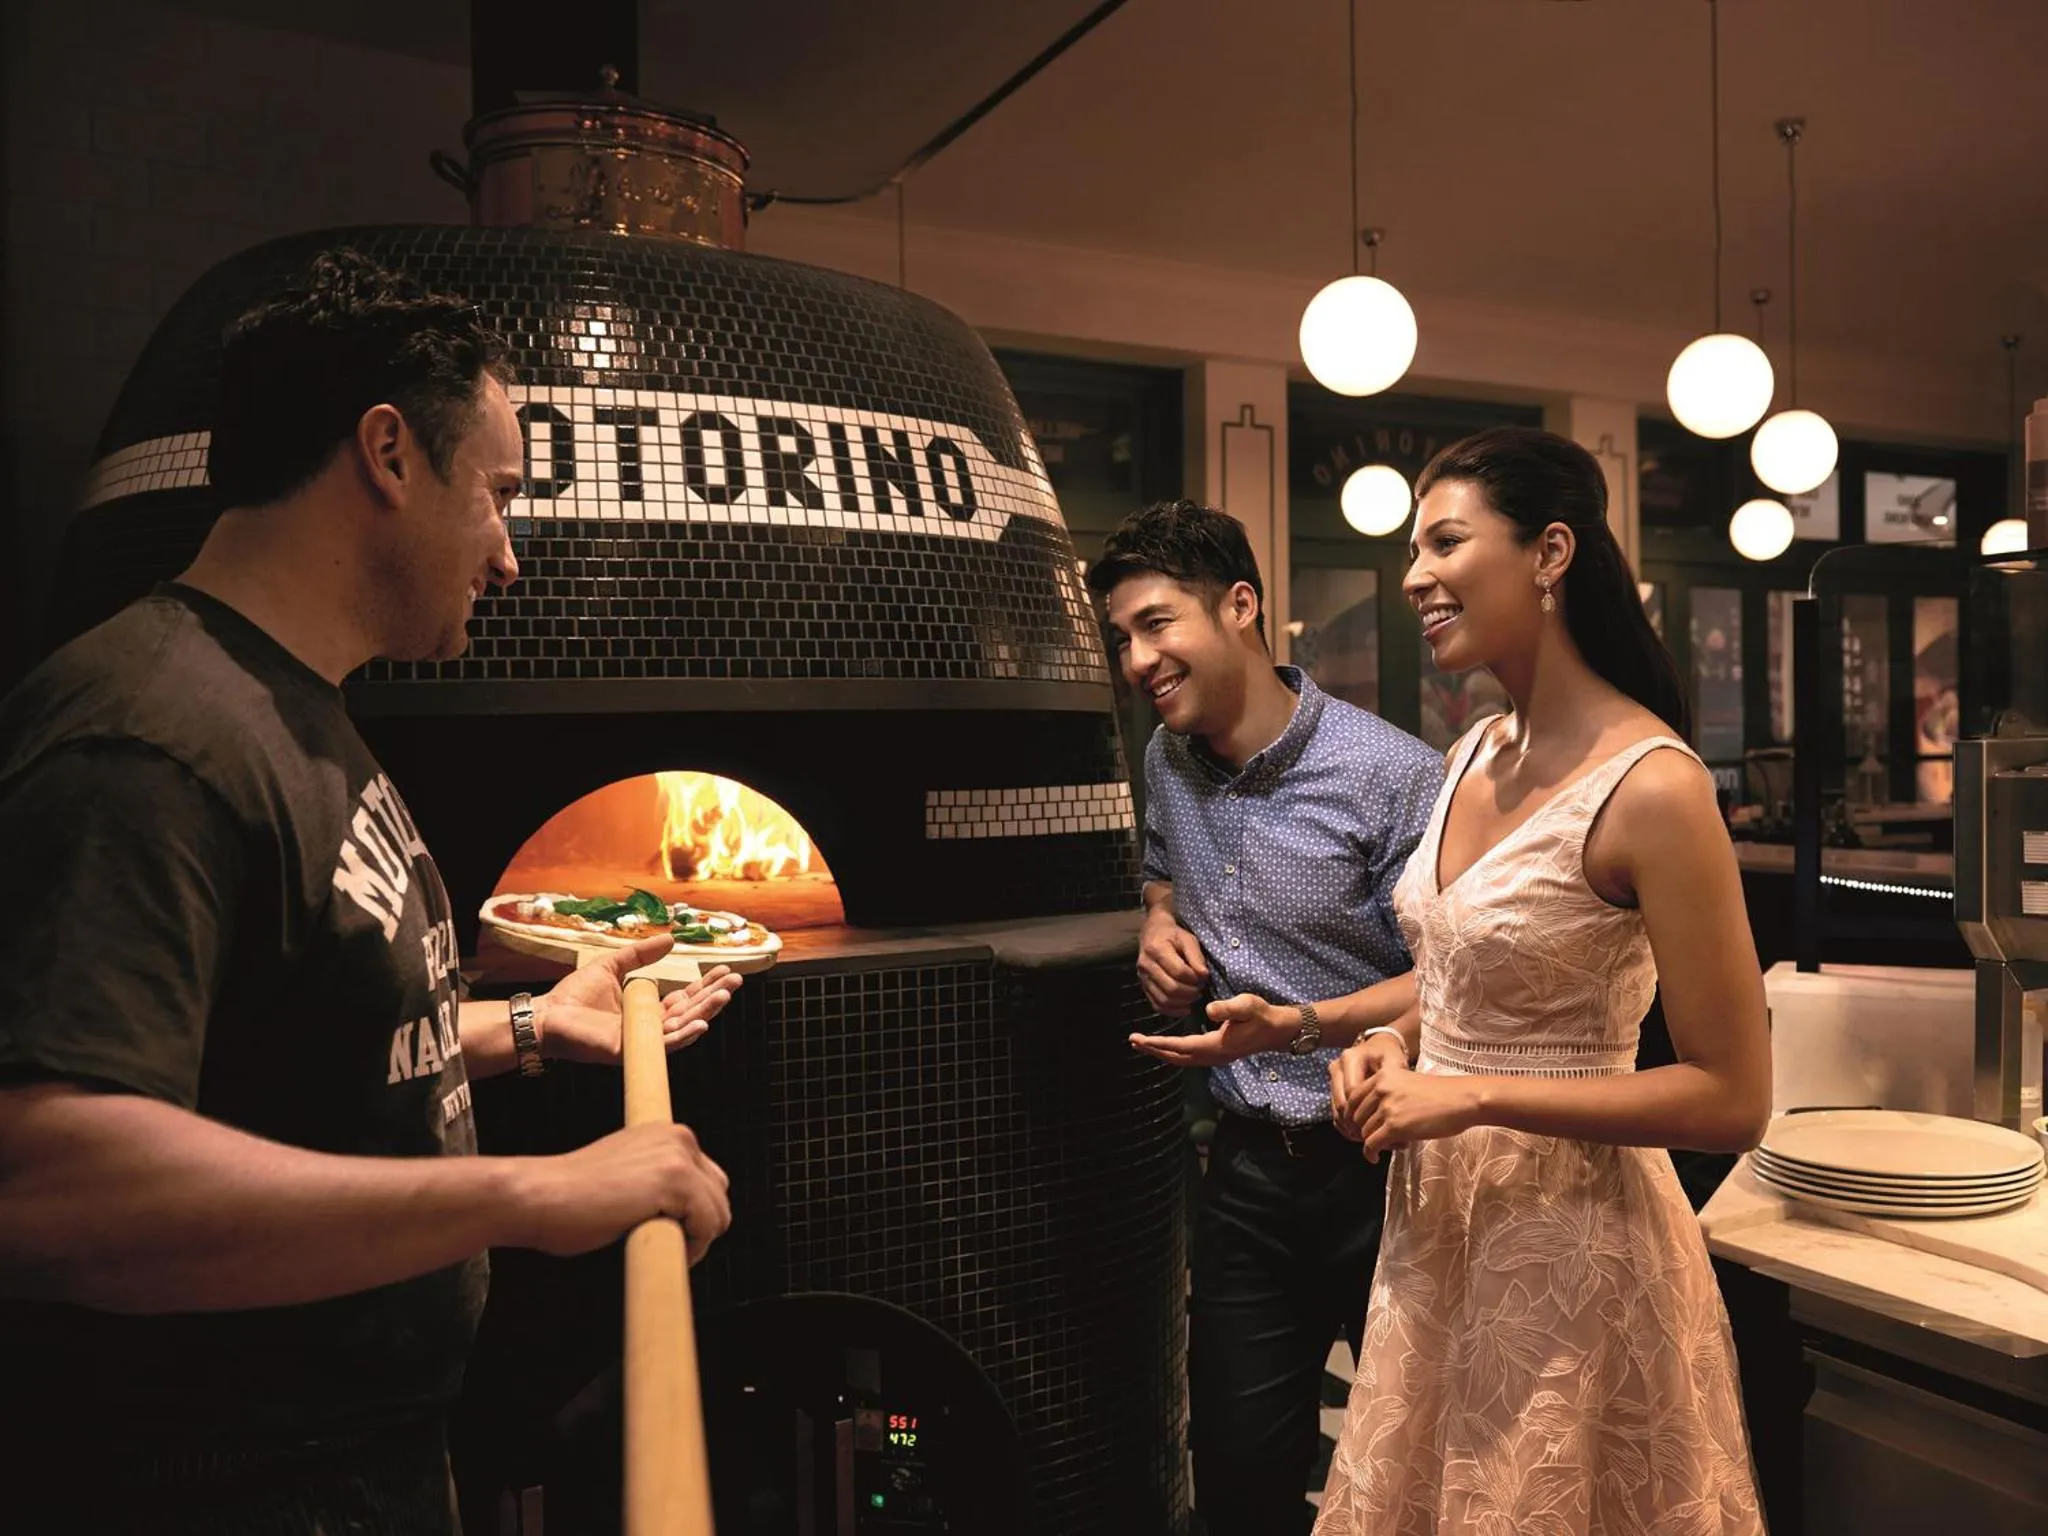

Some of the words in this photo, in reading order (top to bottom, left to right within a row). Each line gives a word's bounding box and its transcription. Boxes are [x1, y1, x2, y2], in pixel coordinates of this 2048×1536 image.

[516, 402, 976, 522] OTORINO
[889, 1415, 918, 1429] 551
[889, 1432, 917, 1447] 472
